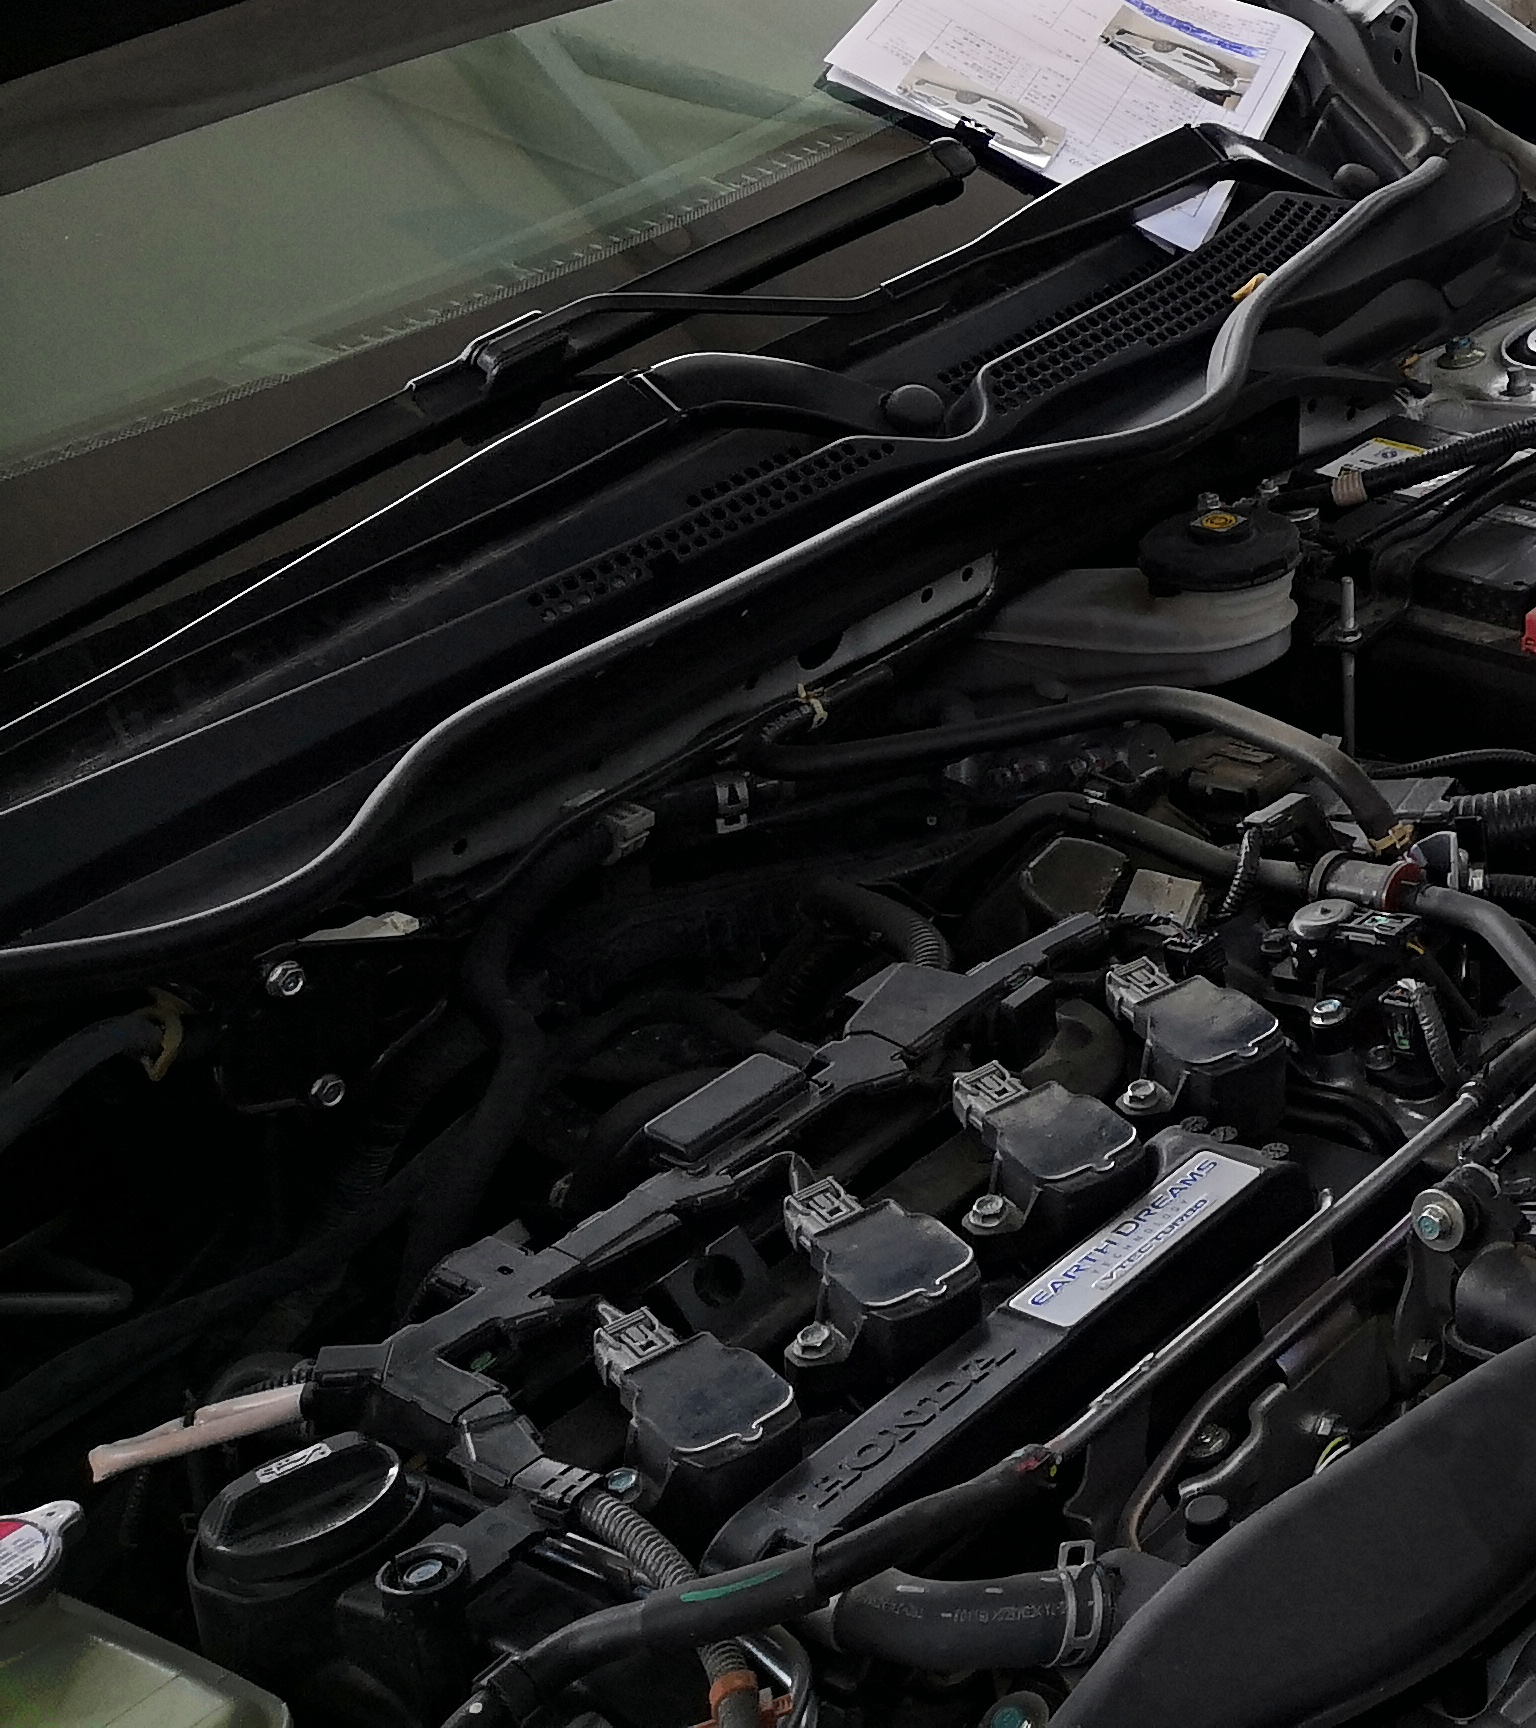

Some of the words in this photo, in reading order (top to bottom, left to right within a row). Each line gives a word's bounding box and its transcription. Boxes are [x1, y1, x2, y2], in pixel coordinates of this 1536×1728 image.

[1028, 1238, 1119, 1307] EARTH
[1111, 1158, 1219, 1238] DREAMS
[797, 1347, 1018, 1510] HONDA
